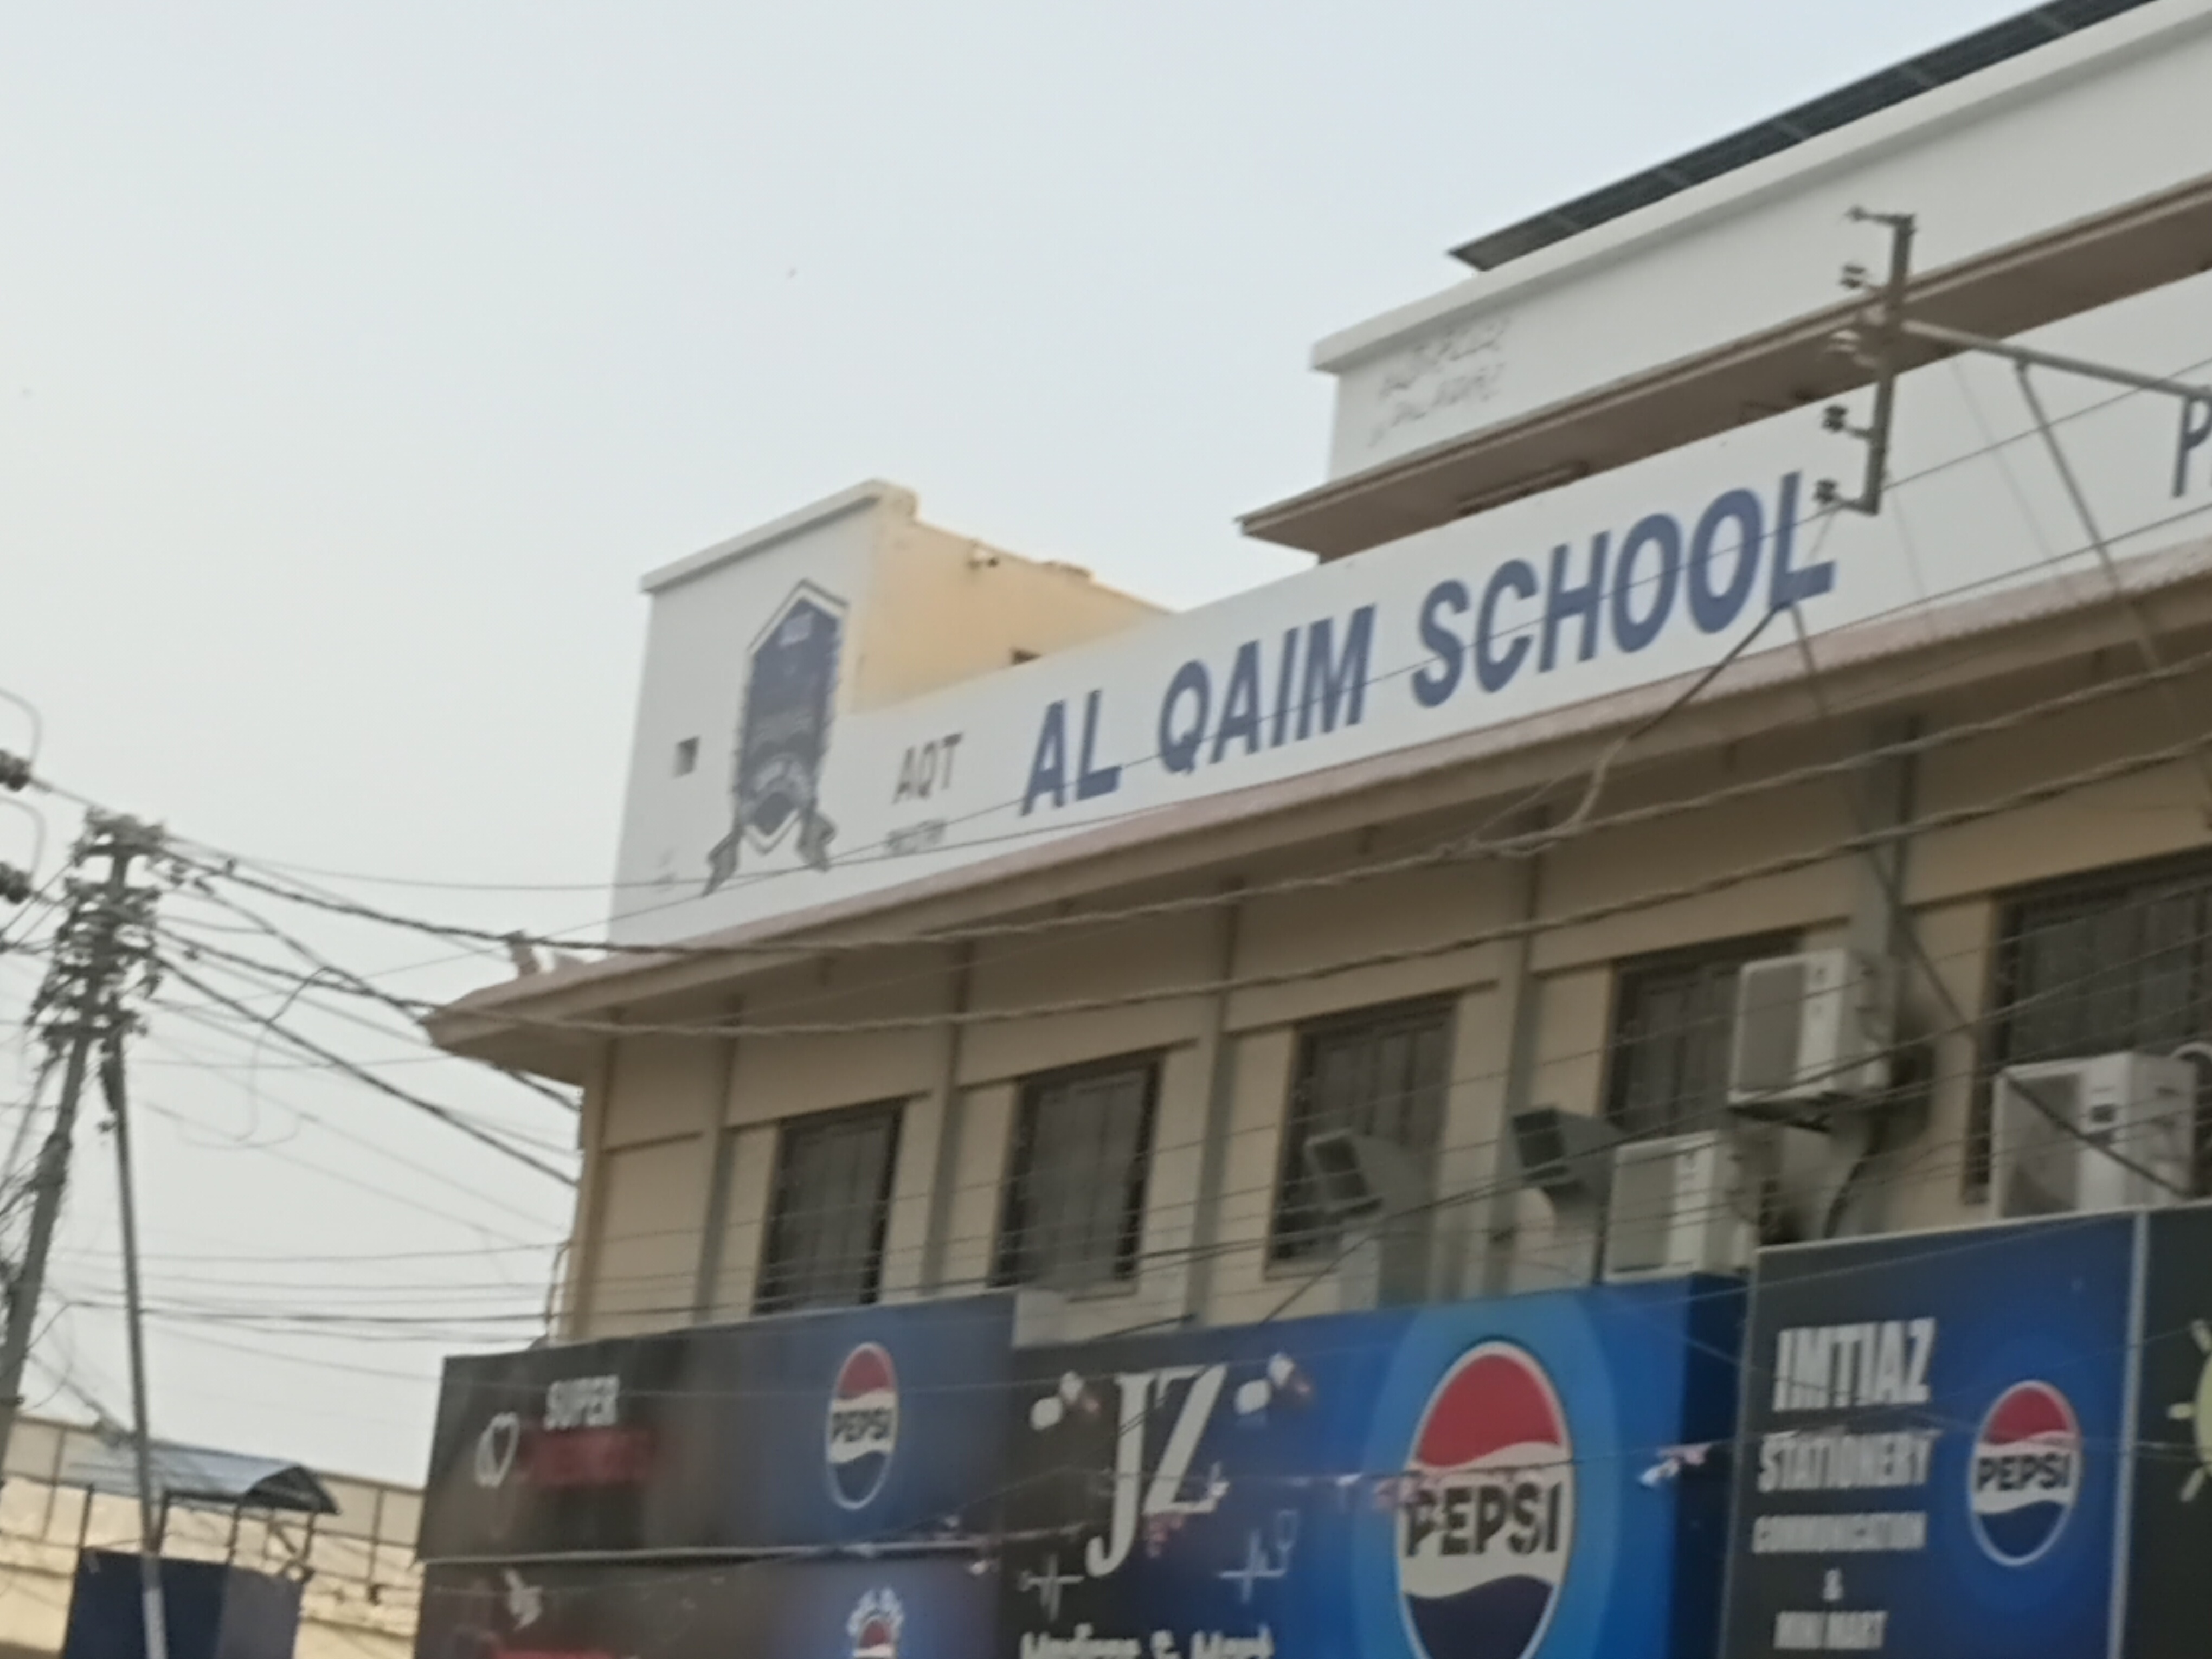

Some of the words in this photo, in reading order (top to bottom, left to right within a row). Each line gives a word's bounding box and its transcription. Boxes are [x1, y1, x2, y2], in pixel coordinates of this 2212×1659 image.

[2170, 384, 2212, 499] P
[1020, 687, 1123, 816] AL
[1158, 602, 1377, 774] QAIM
[1411, 470, 1836, 708] SCHOOL
[1772, 1317, 1937, 1413] IMTIAZ
[1405, 1480, 1562, 1558] PEPSI
[1976, 1452, 2071, 1493] PEPSI
